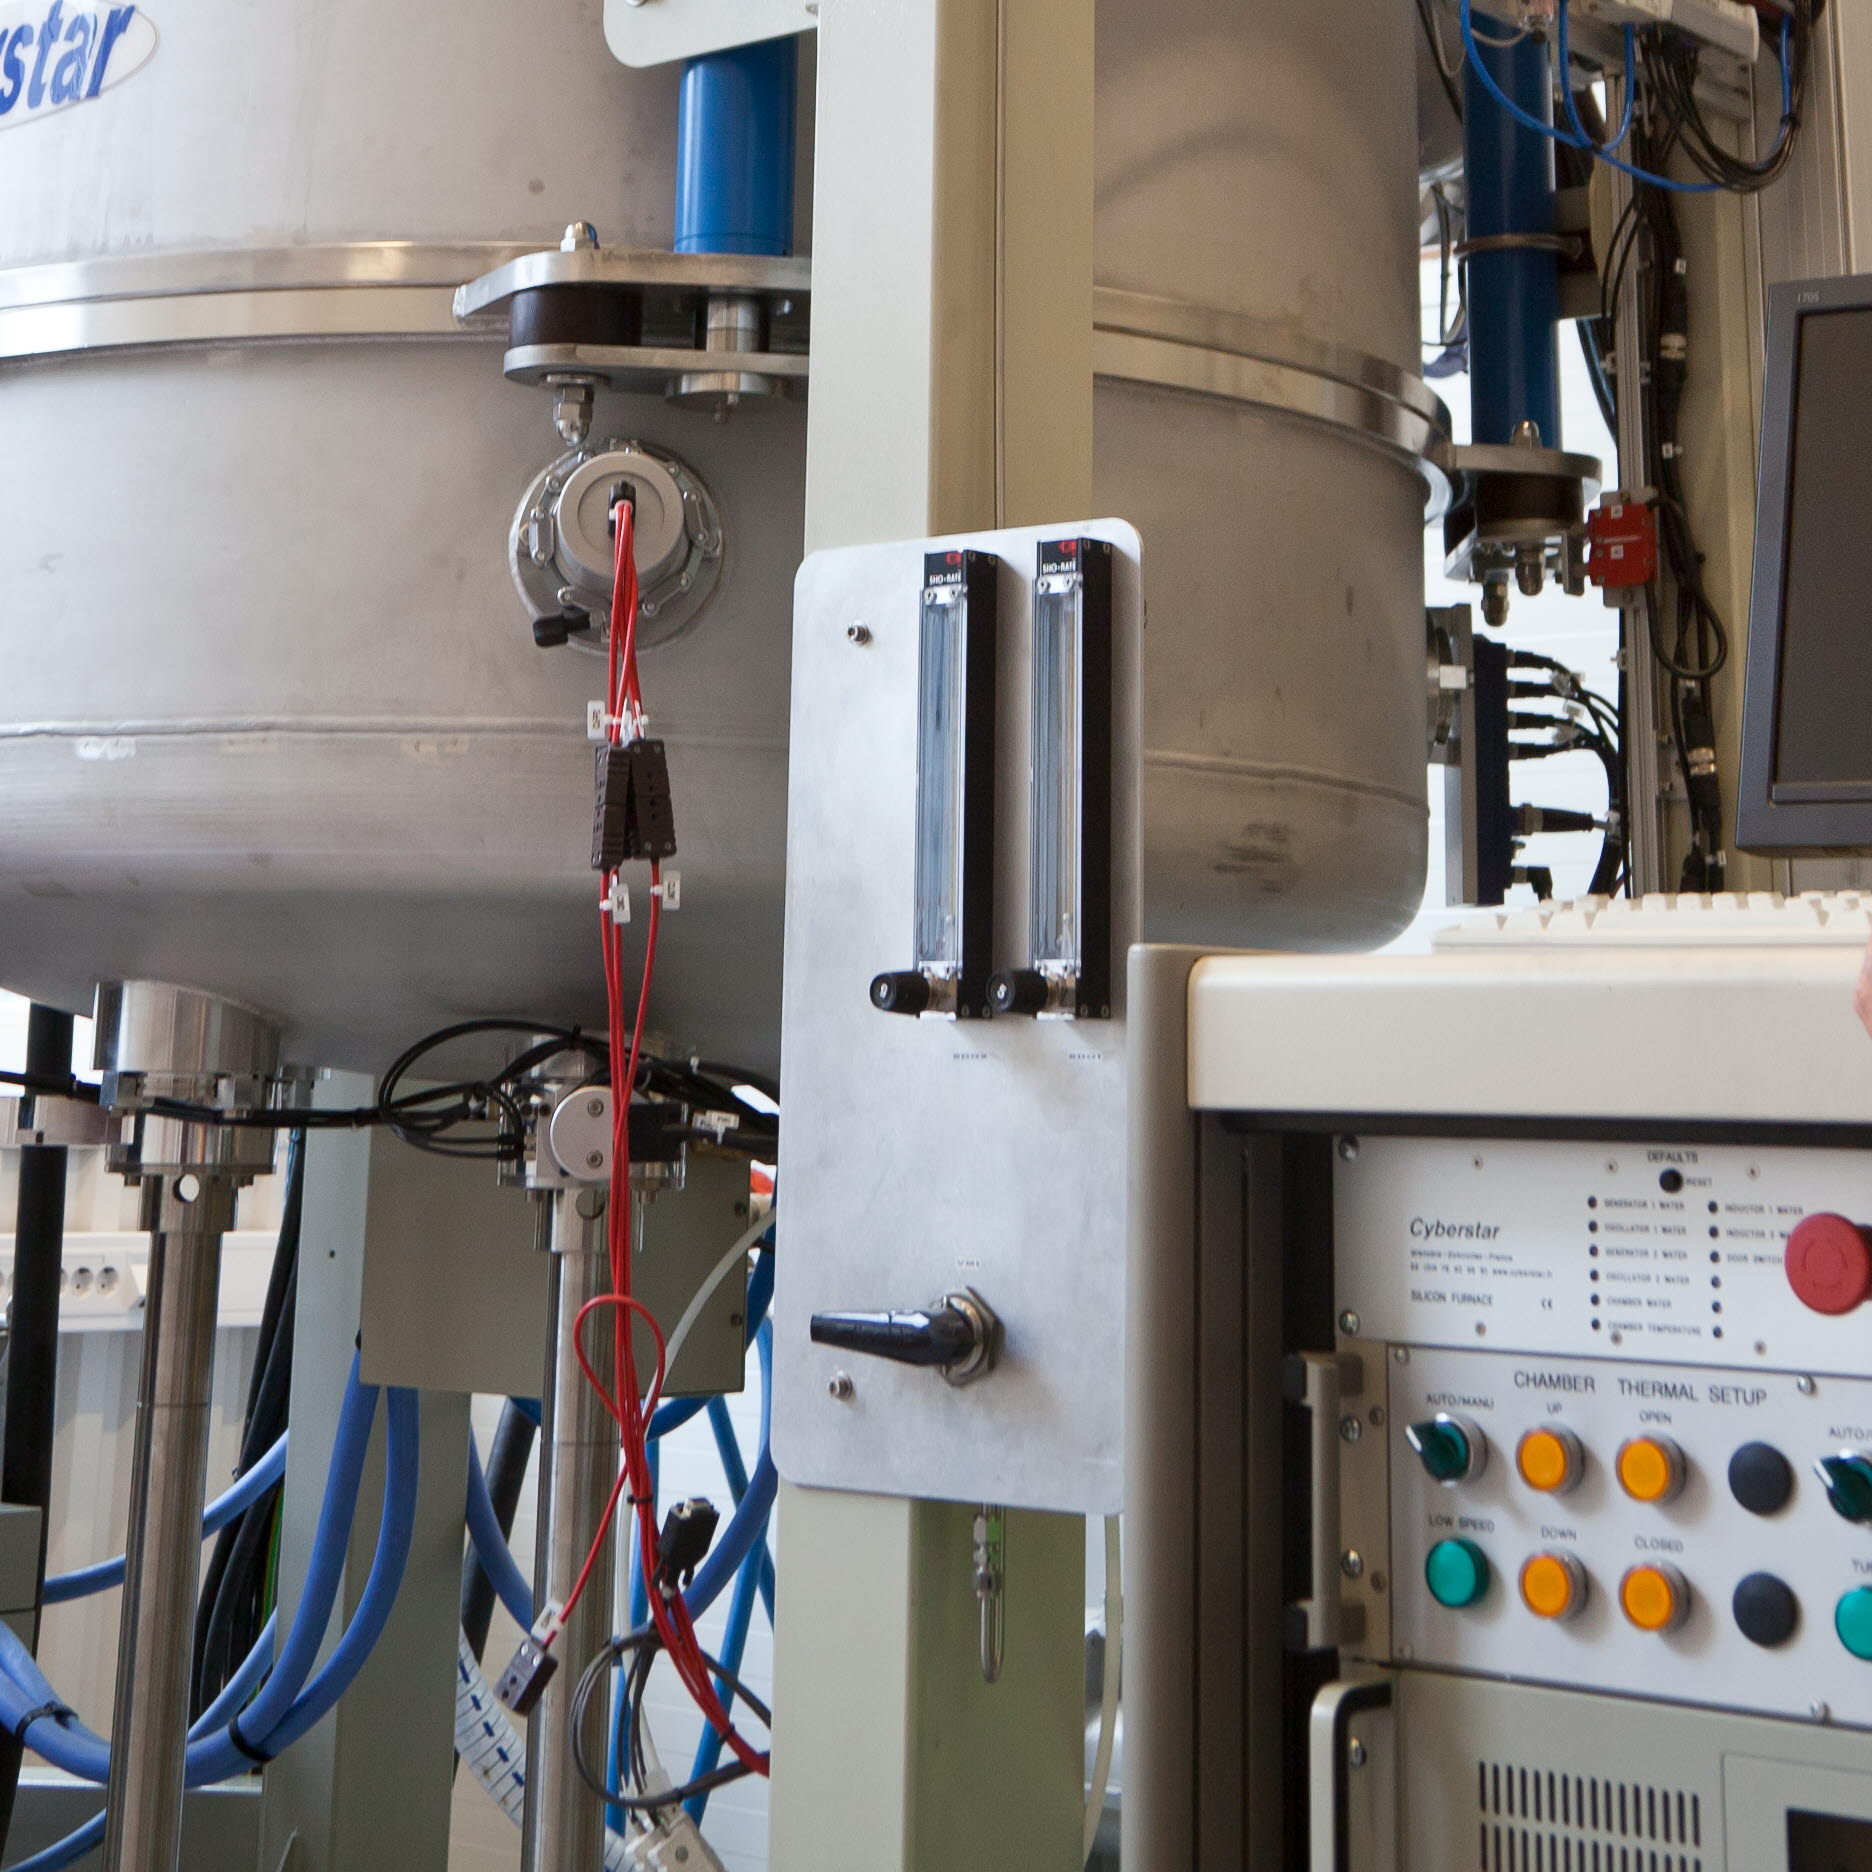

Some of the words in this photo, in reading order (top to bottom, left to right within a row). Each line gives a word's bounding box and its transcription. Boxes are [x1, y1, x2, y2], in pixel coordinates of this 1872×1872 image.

[1647, 1150, 1699, 1164] DEFAULTS
[1410, 1216, 1501, 1241] Cyberstar
[1451, 1291, 1493, 1306] FURNACE
[1513, 1370, 1596, 1393] CHAMBER
[1617, 1377, 1700, 1403] THERMAL
[1708, 1384, 1768, 1407] SETUP
[1426, 1393, 1495, 1410] AUTO/MANU
[1546, 1401, 1563, 1415] UP
[1639, 1409, 1673, 1426] OPEN
[1428, 1514, 1454, 1528] LOW
[1459, 1516, 1495, 1533] SPEED
[1540, 1526, 1578, 1541] DOWN
[1634, 1536, 1685, 1553] CLOSED
